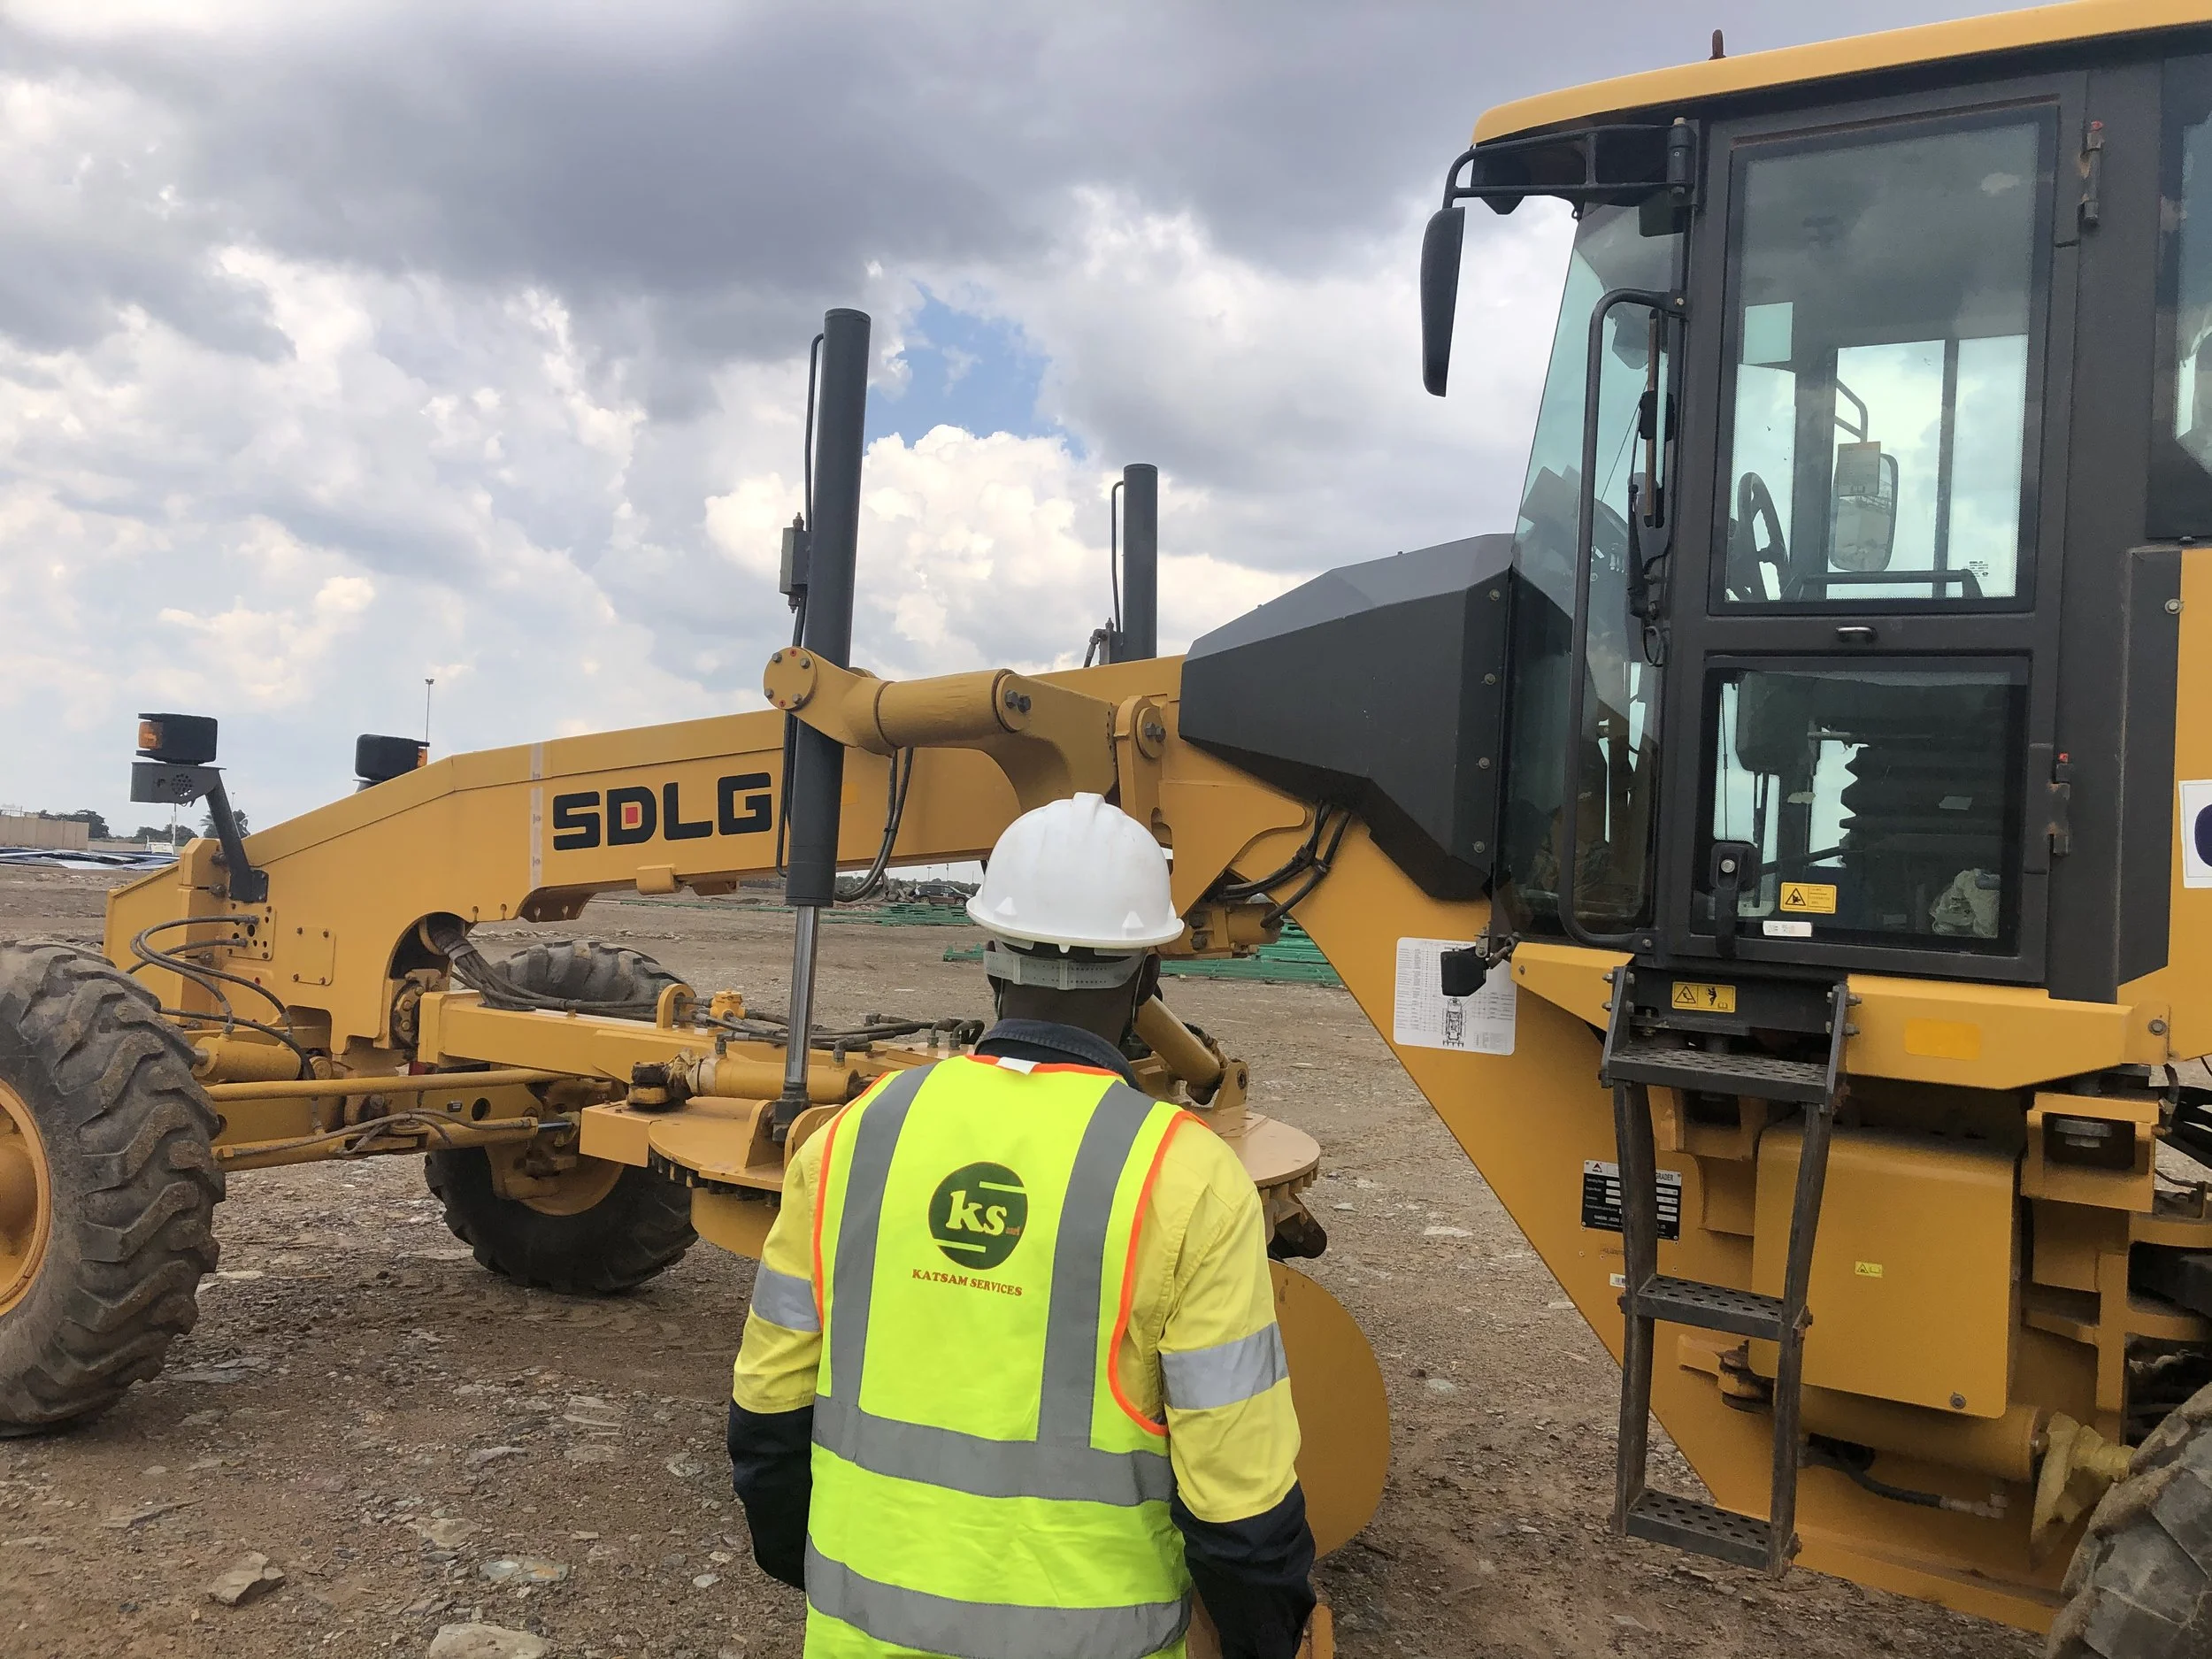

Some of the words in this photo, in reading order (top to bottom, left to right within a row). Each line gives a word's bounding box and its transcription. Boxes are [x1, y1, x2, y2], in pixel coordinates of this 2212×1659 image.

[553, 772, 772, 851] SDLG
[912, 1269, 969, 1286] KATSAM
[970, 1278, 1023, 1296] SERVICES
